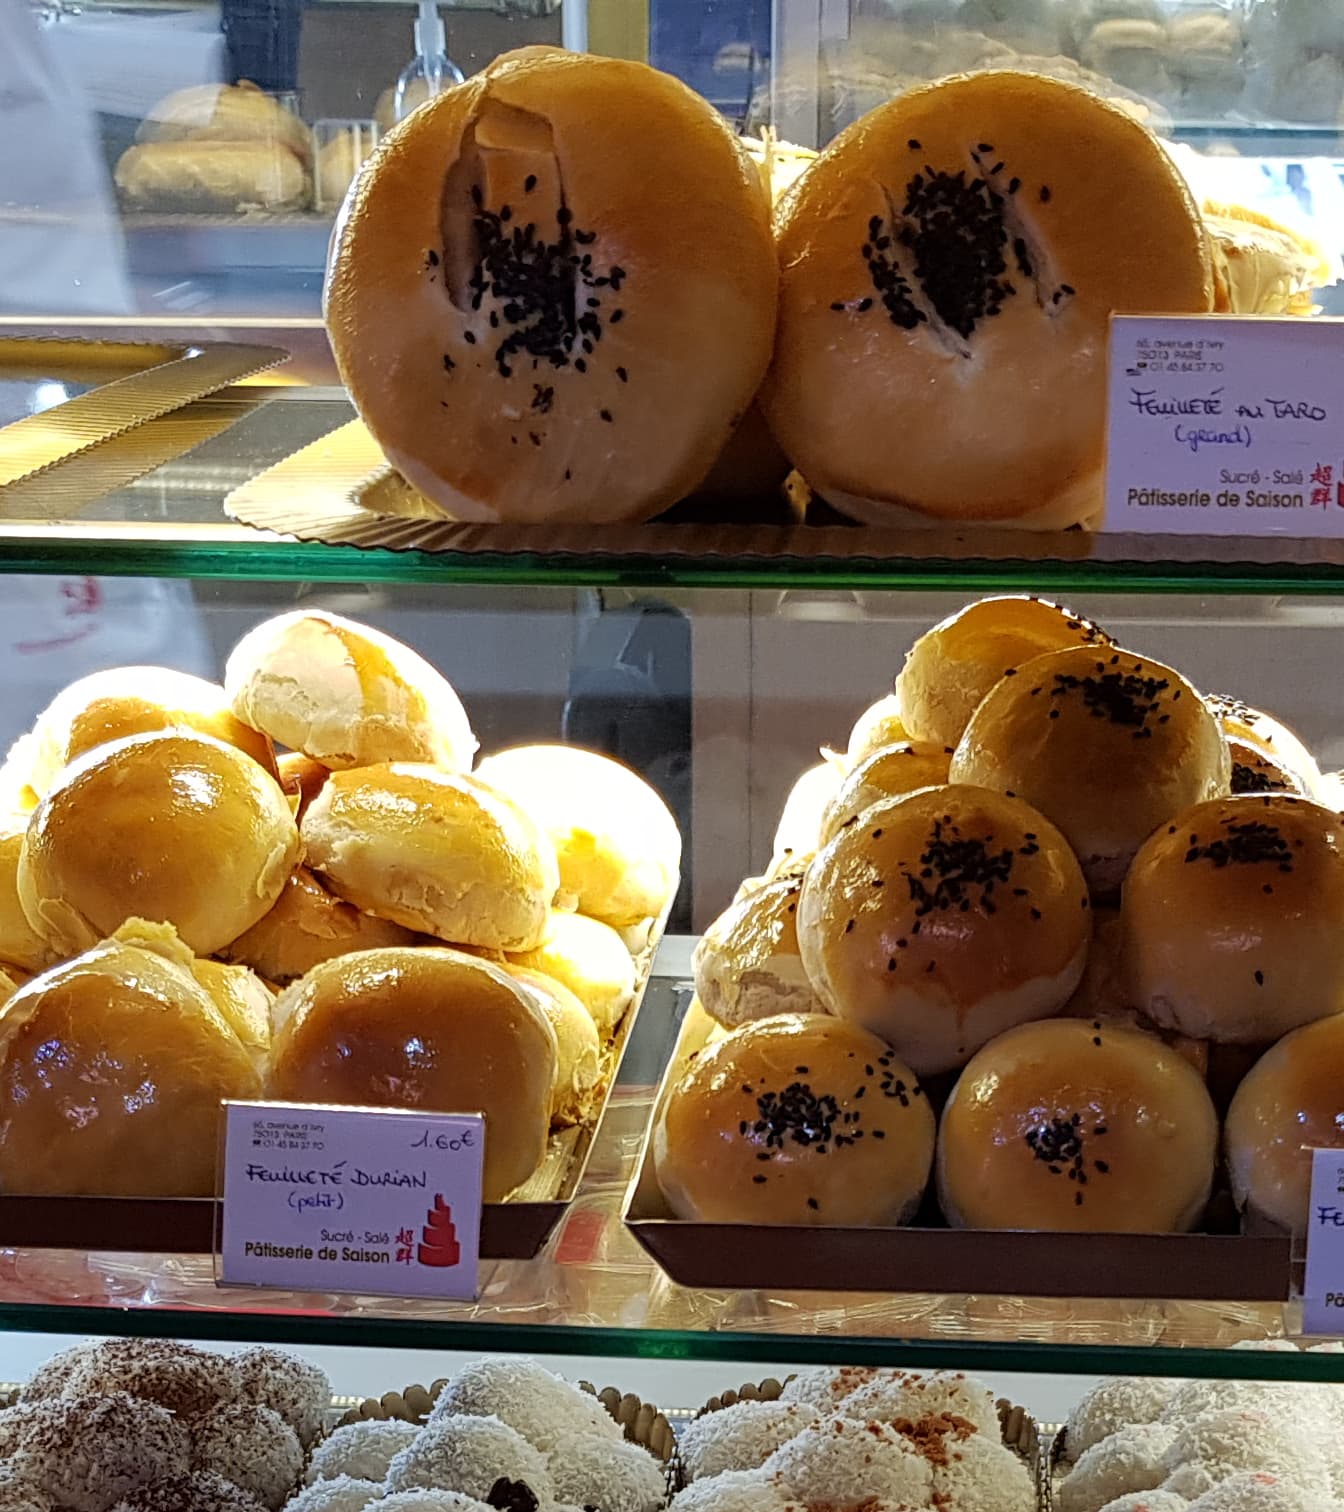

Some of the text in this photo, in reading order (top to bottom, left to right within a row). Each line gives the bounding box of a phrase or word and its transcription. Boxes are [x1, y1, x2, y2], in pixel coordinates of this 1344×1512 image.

[1265, 398, 1326, 420] TARO
[1175, 425, 1251, 451] (grand)
[1220, 470, 1304, 484] Sucré Salé
[1128, 488, 1303, 508] Pâtisserie de Saison
[351, 1169, 426, 1188] DURIAN
[288, 1191, 344, 1213] (petit)
[321, 1229, 389, 1243] Sucré Salé
[245, 1242, 389, 1263] Pâtisserie de Saison
